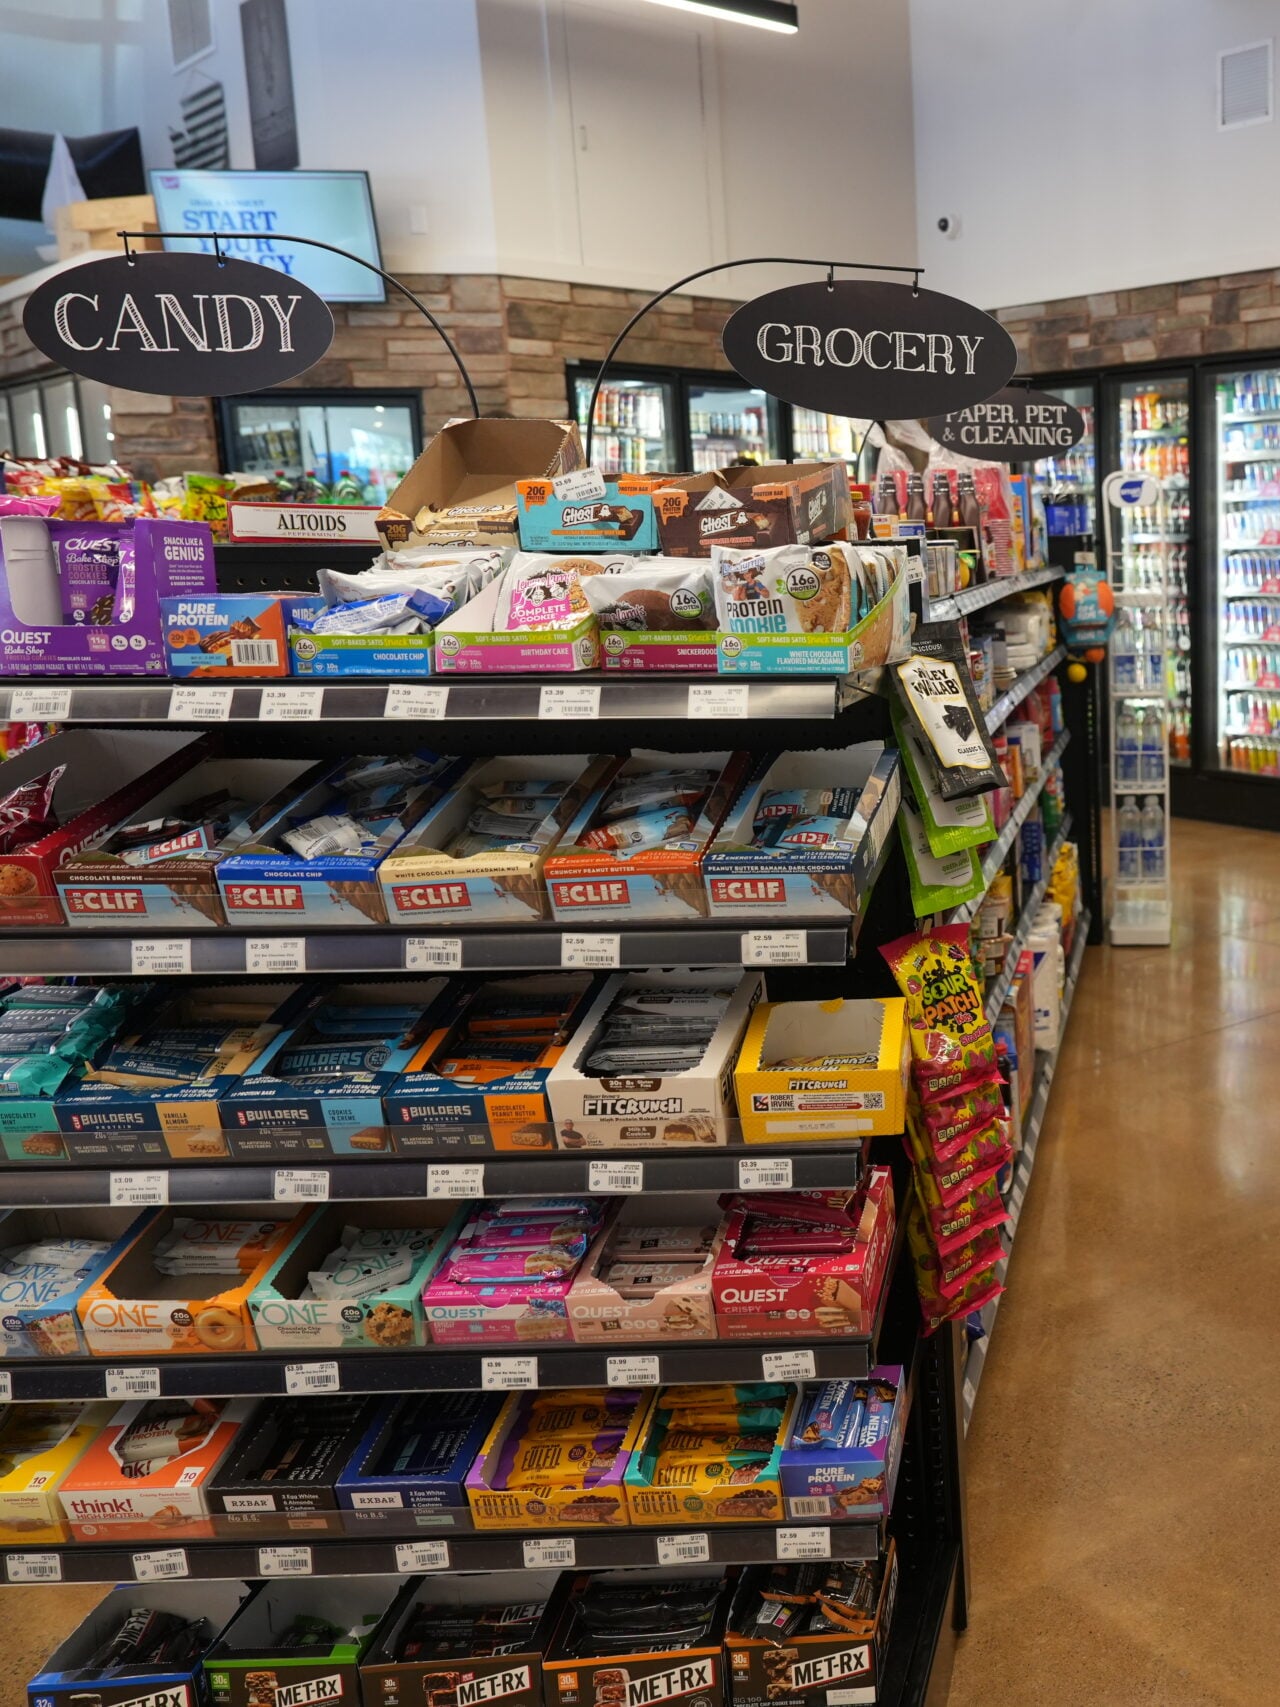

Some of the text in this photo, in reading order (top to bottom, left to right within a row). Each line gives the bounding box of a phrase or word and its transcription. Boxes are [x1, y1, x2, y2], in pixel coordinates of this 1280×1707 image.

[183, 210, 277, 231] START
[54, 292, 301, 353] CANDY
[756, 322, 984, 375] GROCERY
[1025, 405, 1067, 424] PET
[942, 426, 1072, 446] & CLEANING
[526, 486, 545, 496] 20G
[277, 513, 347, 531] ALTOIDS
[562, 506, 599, 527] GHOST
[700, 513, 734, 536] GHOST
[164, 548, 205, 561] GENIUS
[791, 576, 815, 585] 16G
[675, 594, 696, 605] 16G
[178, 604, 215, 614] PURE
[168, 614, 228, 626] PROTEIN
[1, 630, 51, 644] QUEST
[373, 653, 425, 661] CHOCOLATE CHIP
[242, 887, 297, 906] CLIF
[414, 886, 464, 906] CLIF
[559, 883, 623, 904] BAR CLIF
[728, 882, 779, 900] CLIF
[923, 973, 968, 1005] SOUR
[924, 990, 979, 1026] PATCH
[82, 1113, 144, 1124] BUILDERS
[247, 1110, 308, 1120] BUILDERS
[721, 1288, 788, 1304] QUEST
[262, 1304, 328, 1326] ONE
[572, 1305, 633, 1319] QUEST
[808, 1473, 855, 1483] PROTEIN
[815, 1467, 845, 1478] PURE
[71, 1499, 133, 1514] think!
[231, 1500, 268, 1508] RXBAR
[359, 1496, 397, 1505] RXBAR
